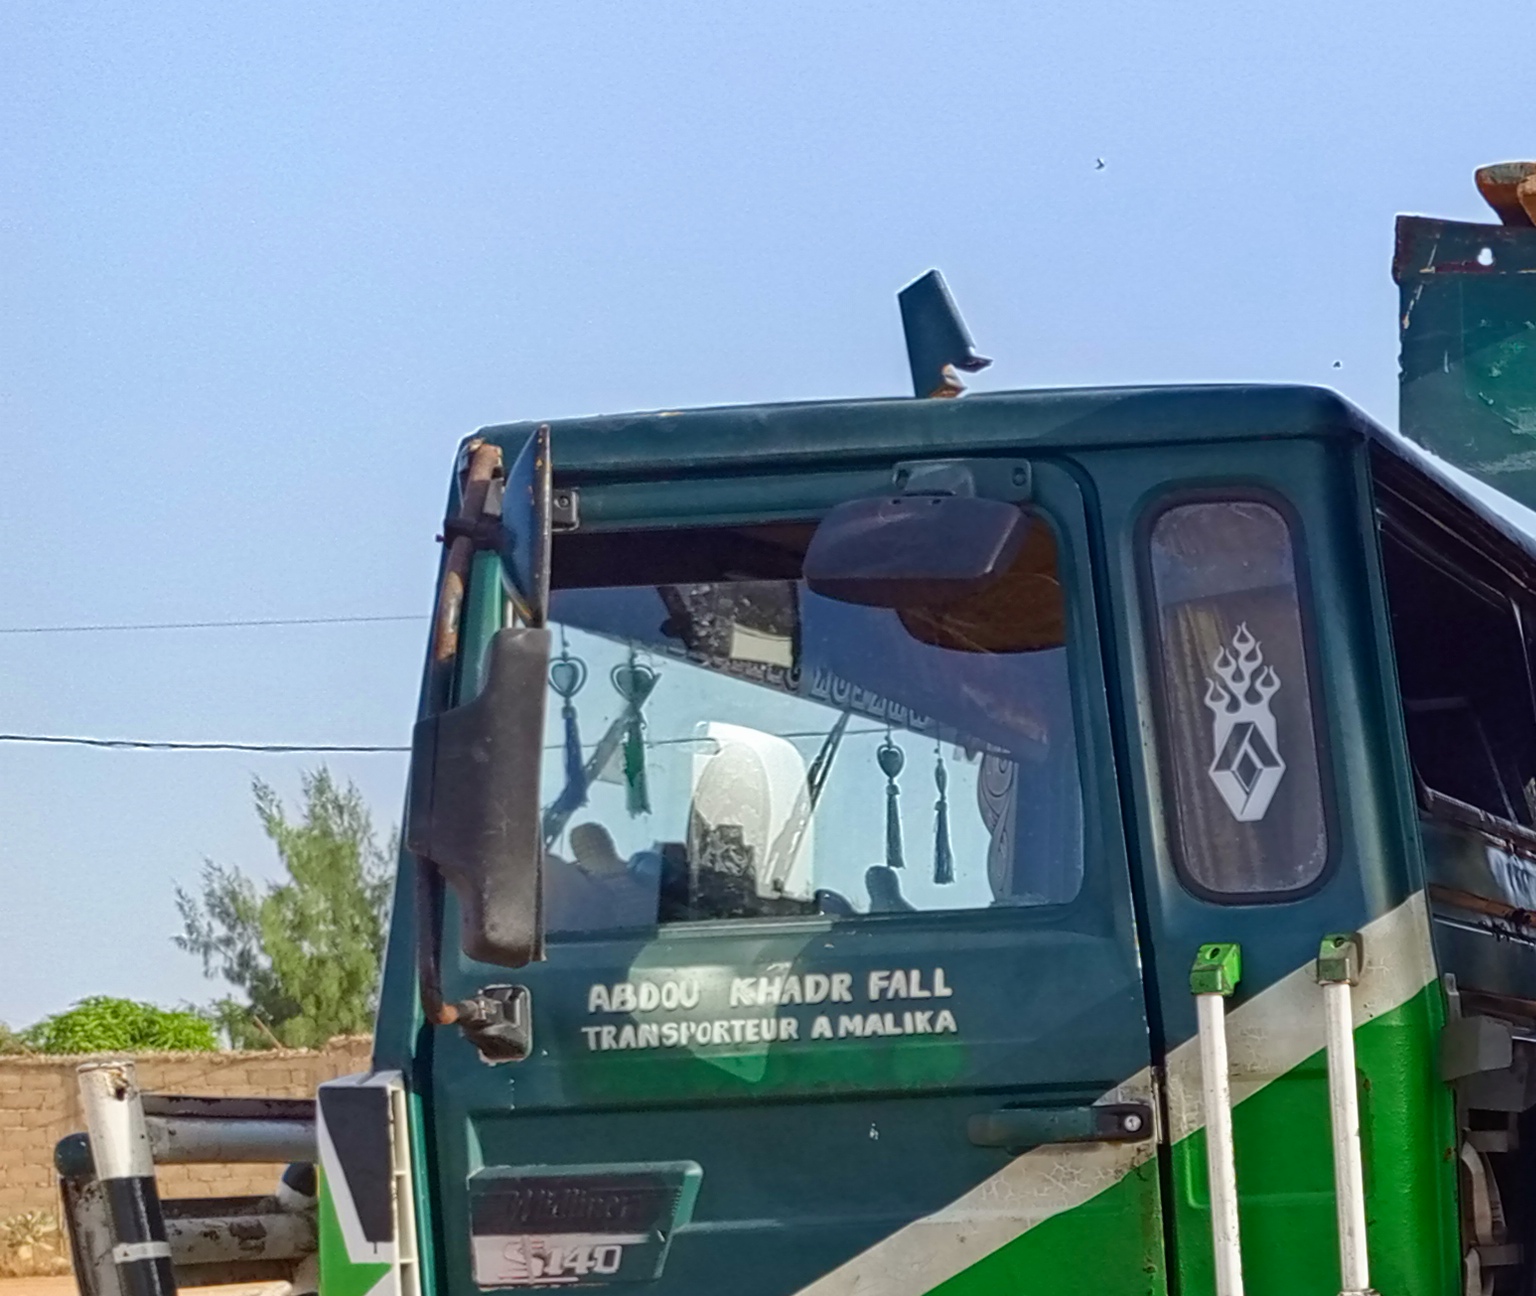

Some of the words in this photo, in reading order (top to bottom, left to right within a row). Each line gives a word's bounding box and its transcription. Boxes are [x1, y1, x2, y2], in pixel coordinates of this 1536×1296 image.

[588, 982, 701, 1013] ABDOU
[868, 967, 954, 1000] FALL
[581, 1015, 798, 1051] TRANSPORTEUR
[839, 1009, 958, 1038] MALIKA
